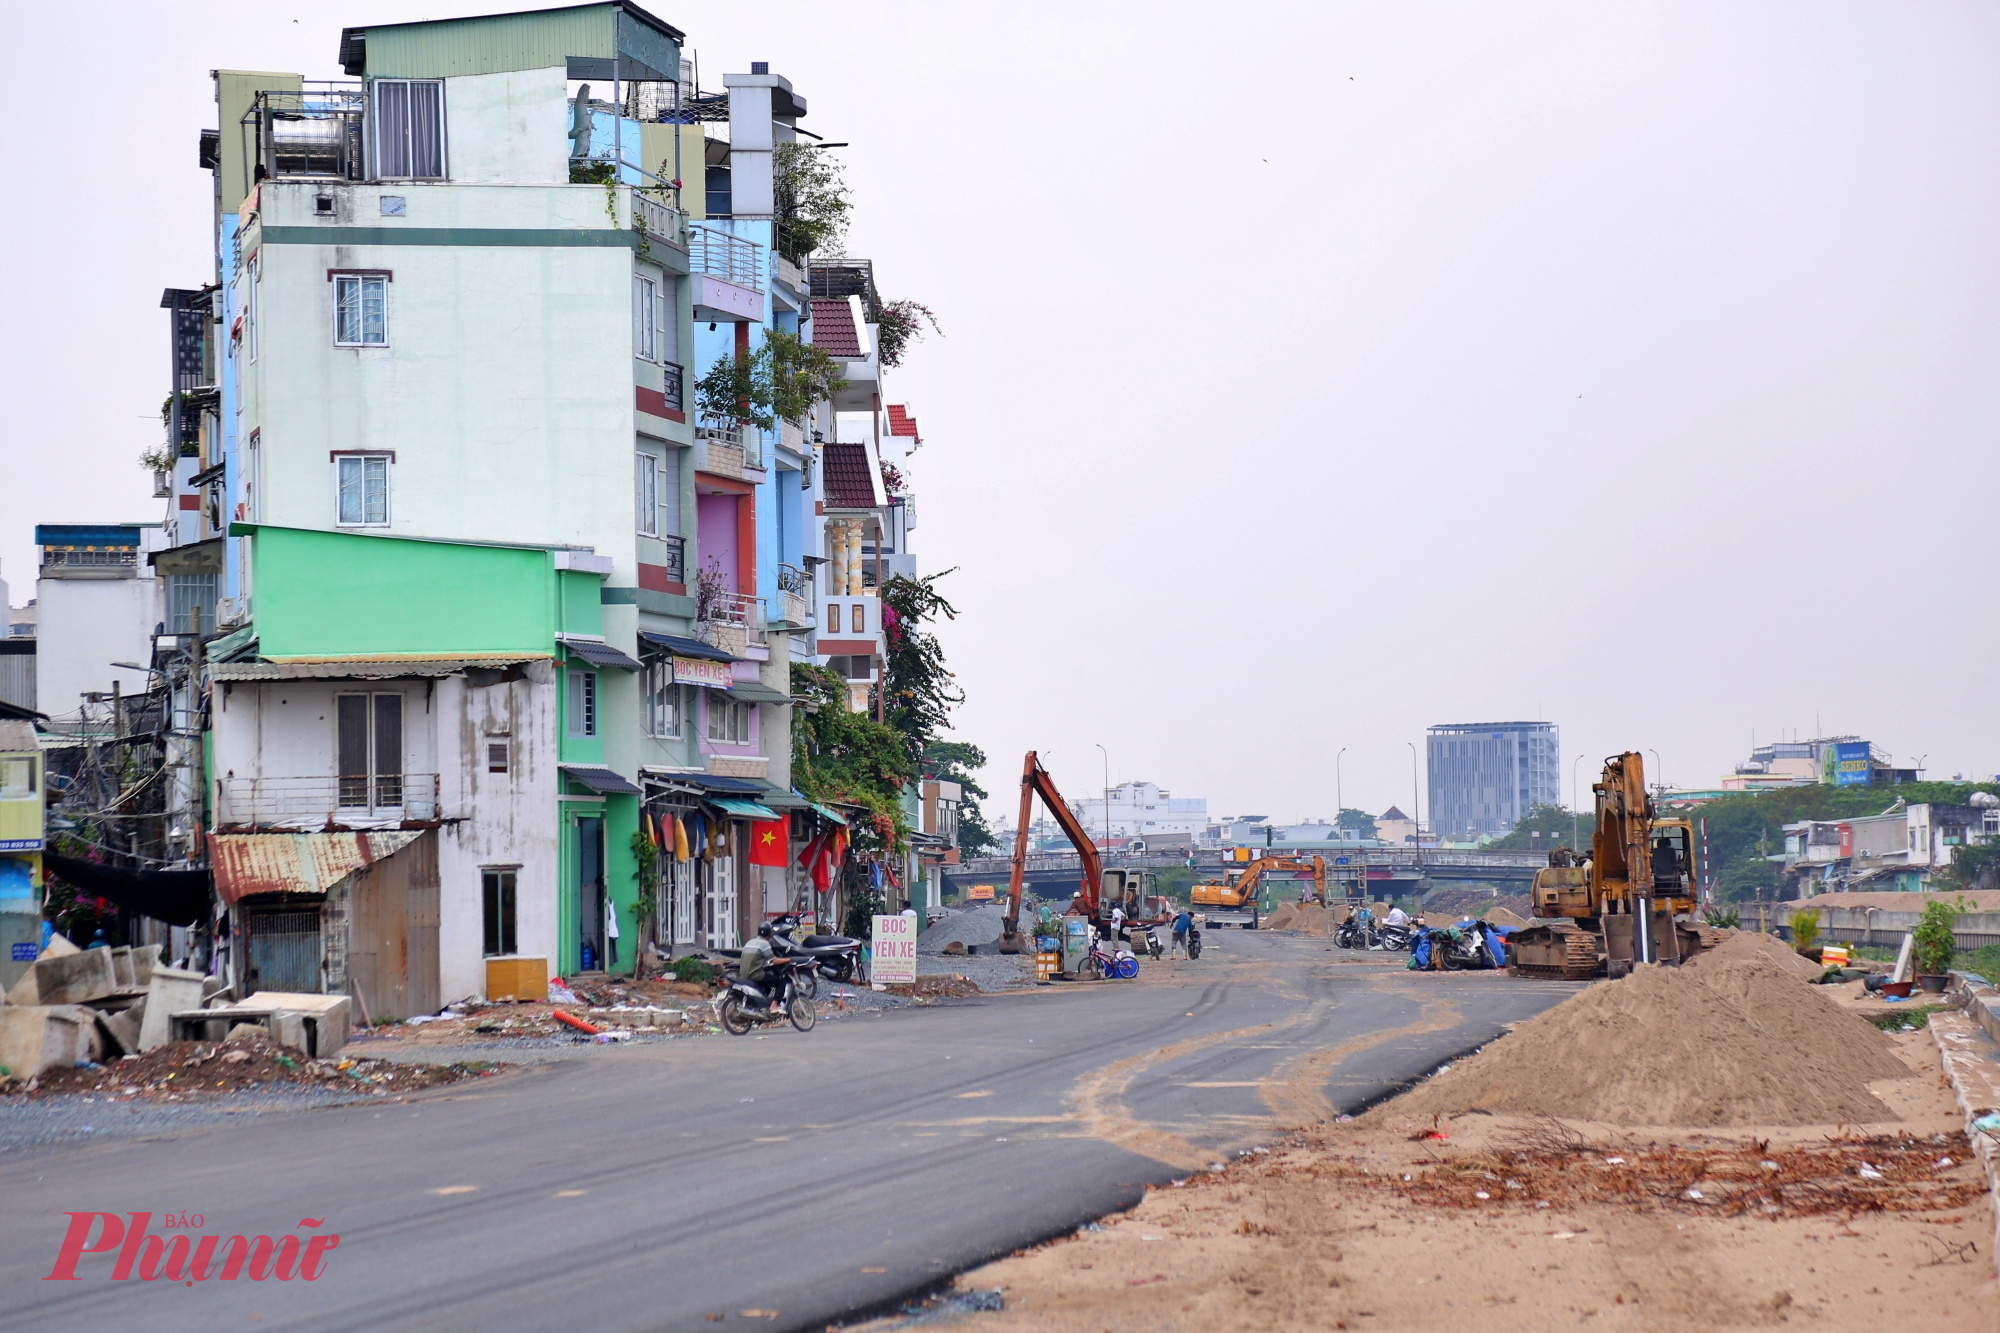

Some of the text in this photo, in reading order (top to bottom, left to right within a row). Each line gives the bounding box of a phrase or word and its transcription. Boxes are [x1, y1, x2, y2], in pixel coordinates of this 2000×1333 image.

[713, 665, 723, 680] XE
[1840, 759, 1868, 772] SENKO
[881, 918, 907, 937] BỌC
[874, 937, 914, 958] YÊN XE
